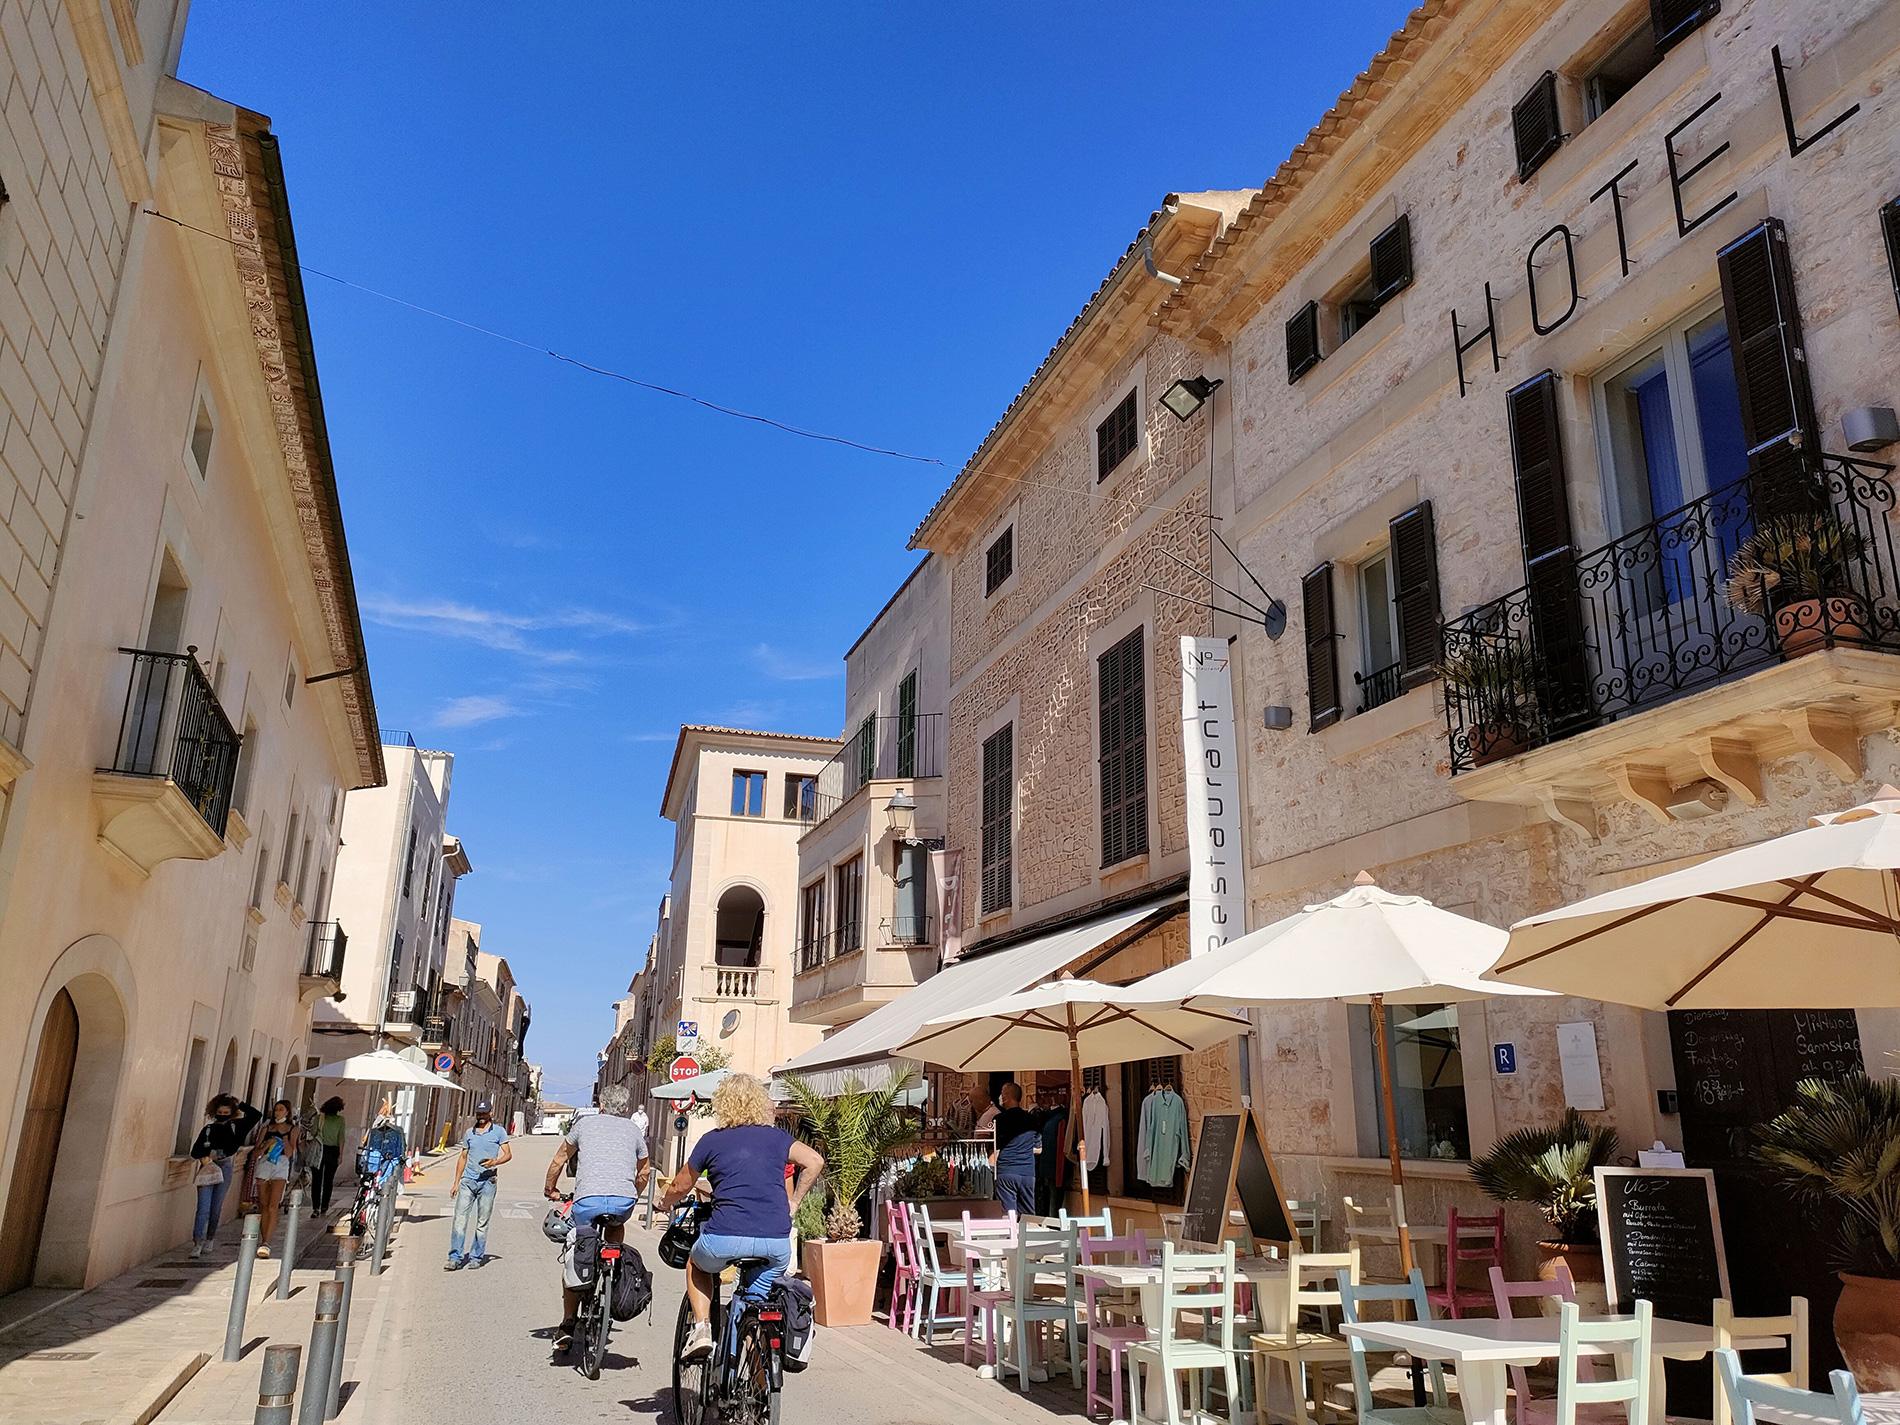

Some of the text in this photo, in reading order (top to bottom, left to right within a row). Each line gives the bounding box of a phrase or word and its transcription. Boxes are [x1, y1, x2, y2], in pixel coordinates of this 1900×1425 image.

[1452, 44, 1860, 398] HOTEL
[1499, 1048, 1510, 1065] R
[673, 1068, 698, 1076] STOP
